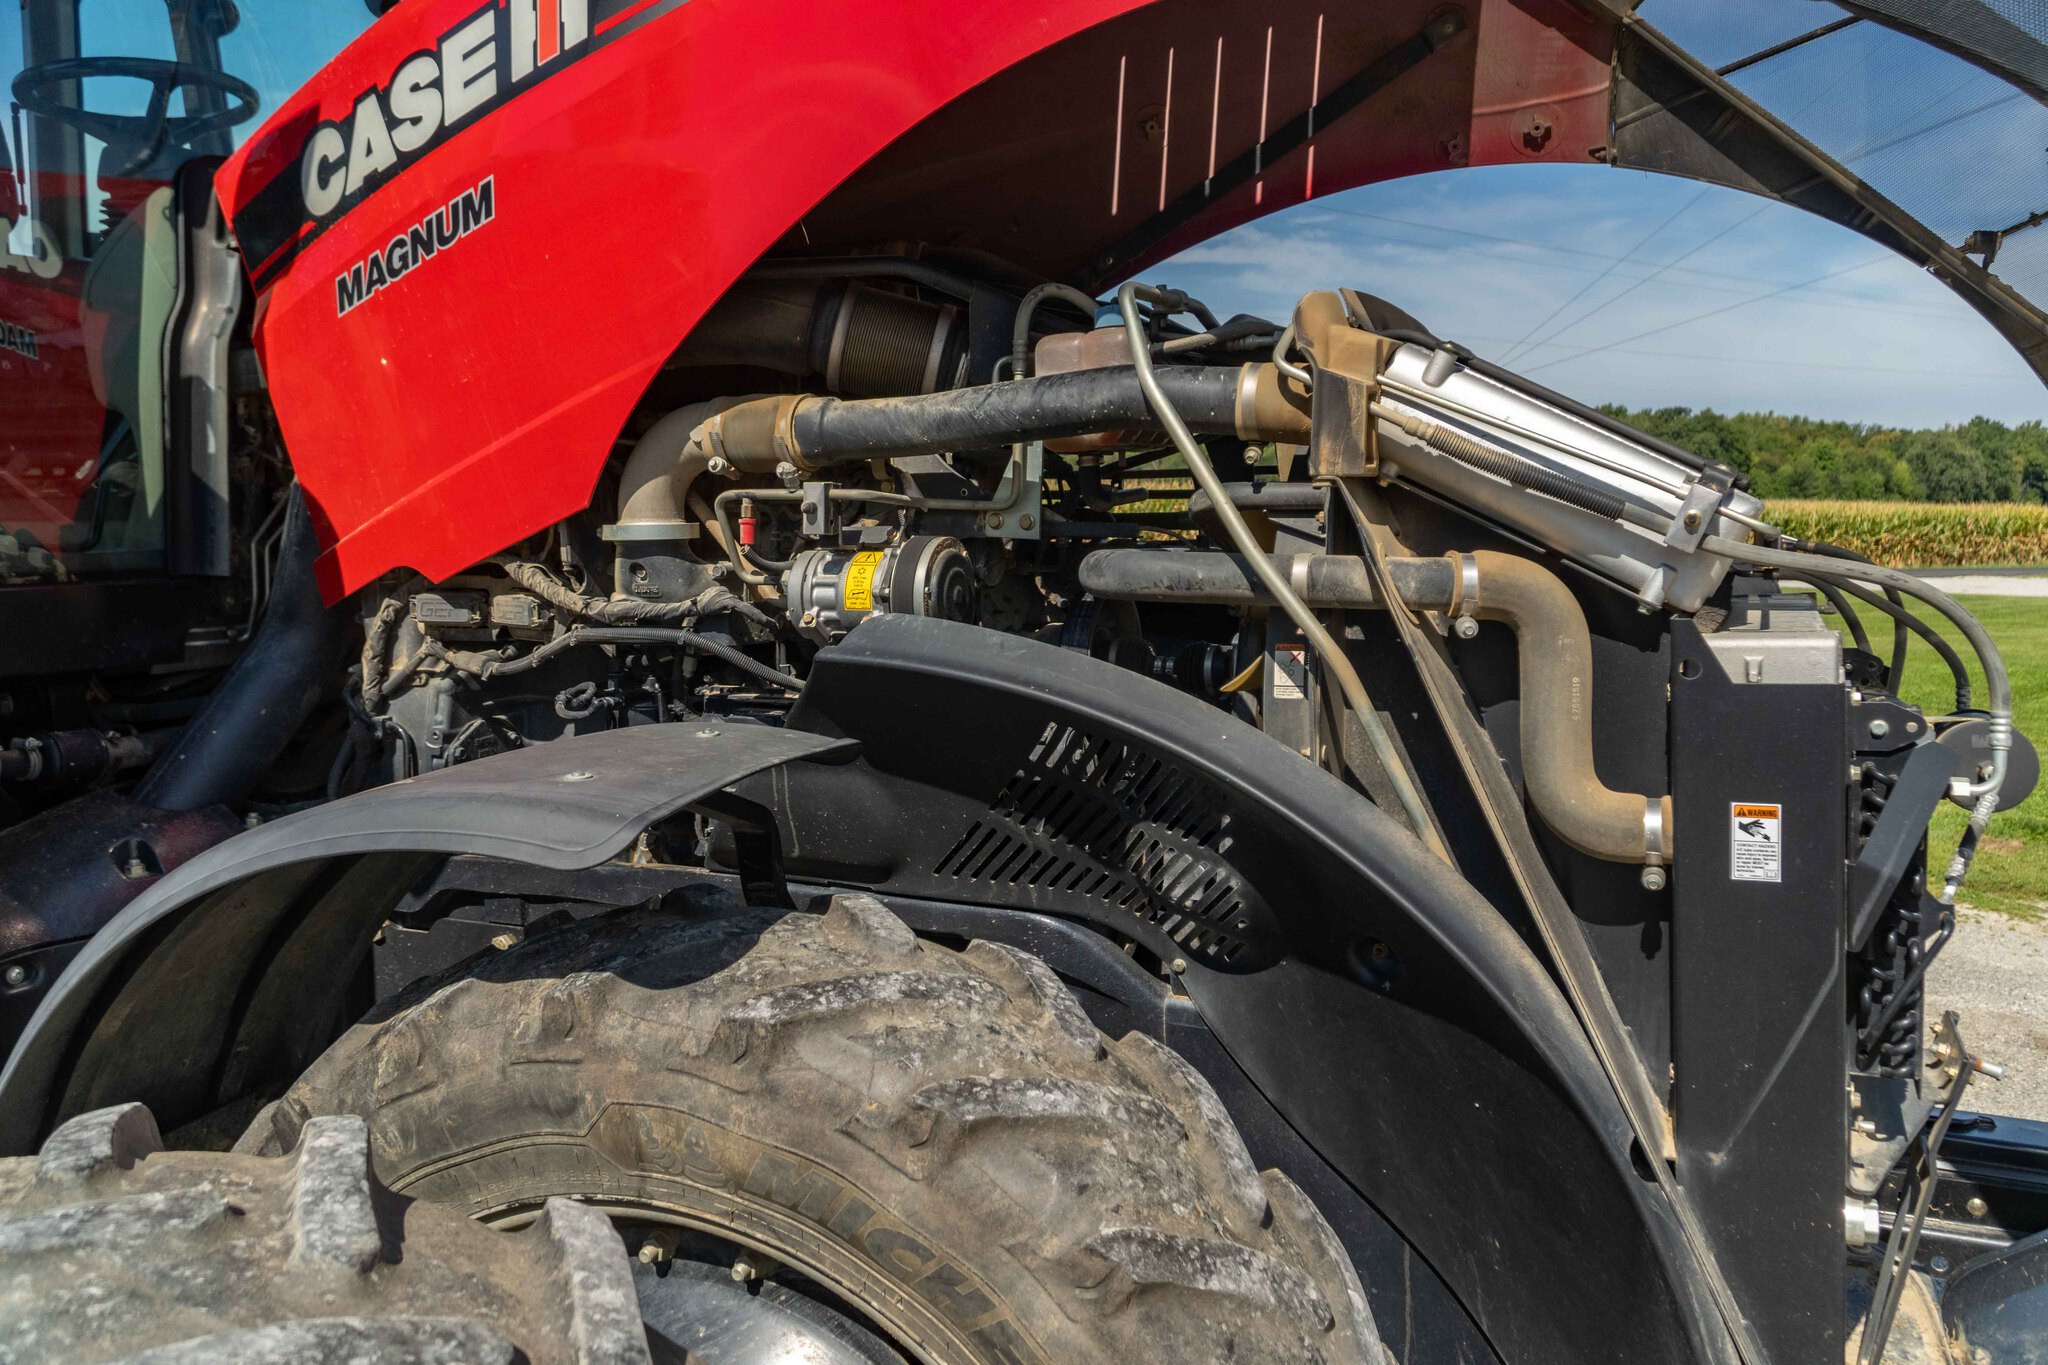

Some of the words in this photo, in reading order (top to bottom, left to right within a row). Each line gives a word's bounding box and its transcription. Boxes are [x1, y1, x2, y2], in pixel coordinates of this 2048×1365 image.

[301, 9, 498, 217] CASE
[336, 174, 496, 318] MAGNUM
[1747, 808, 1777, 817] WARNING
